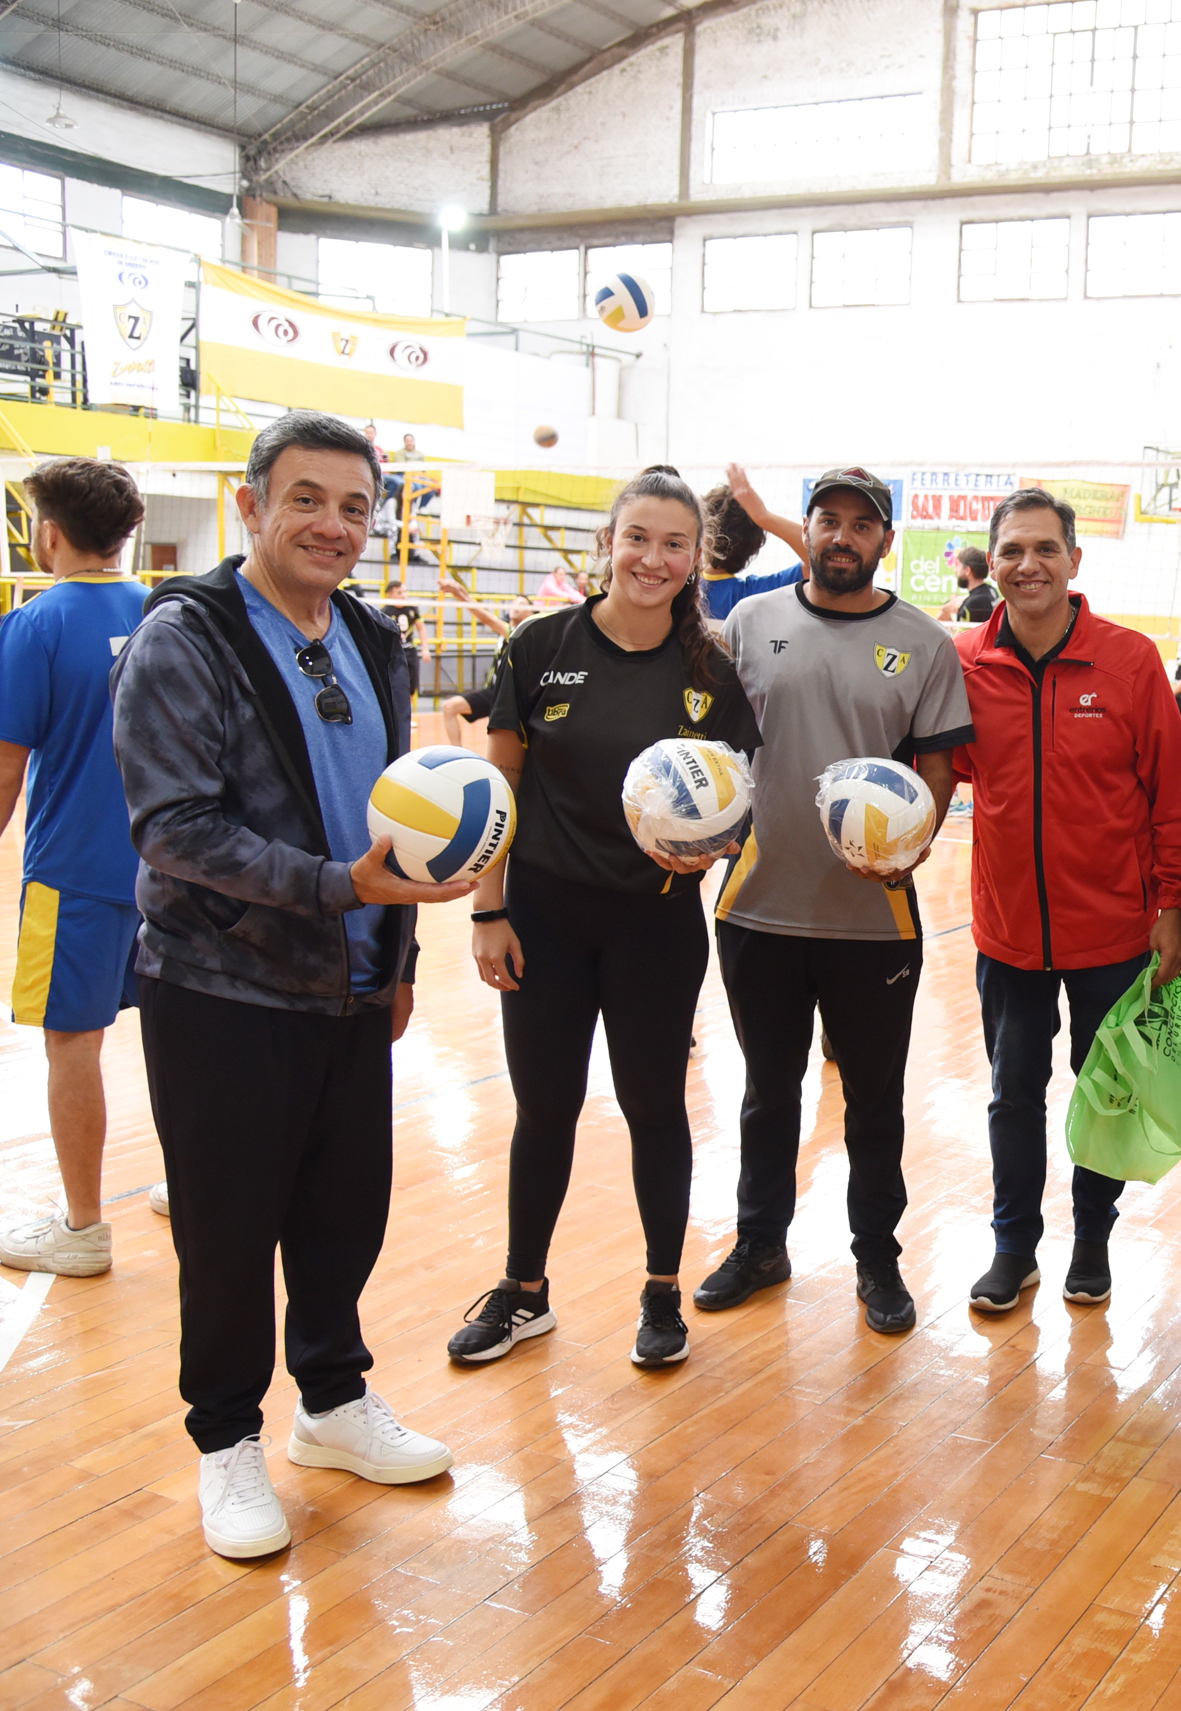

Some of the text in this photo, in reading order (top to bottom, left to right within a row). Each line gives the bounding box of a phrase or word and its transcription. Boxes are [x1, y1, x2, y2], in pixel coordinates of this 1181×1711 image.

[911, 472, 1014, 487] FERRETERIA
[911, 493, 943, 520] SAN
[910, 556, 940, 575] del
[468, 809, 507, 875] PINTIER
